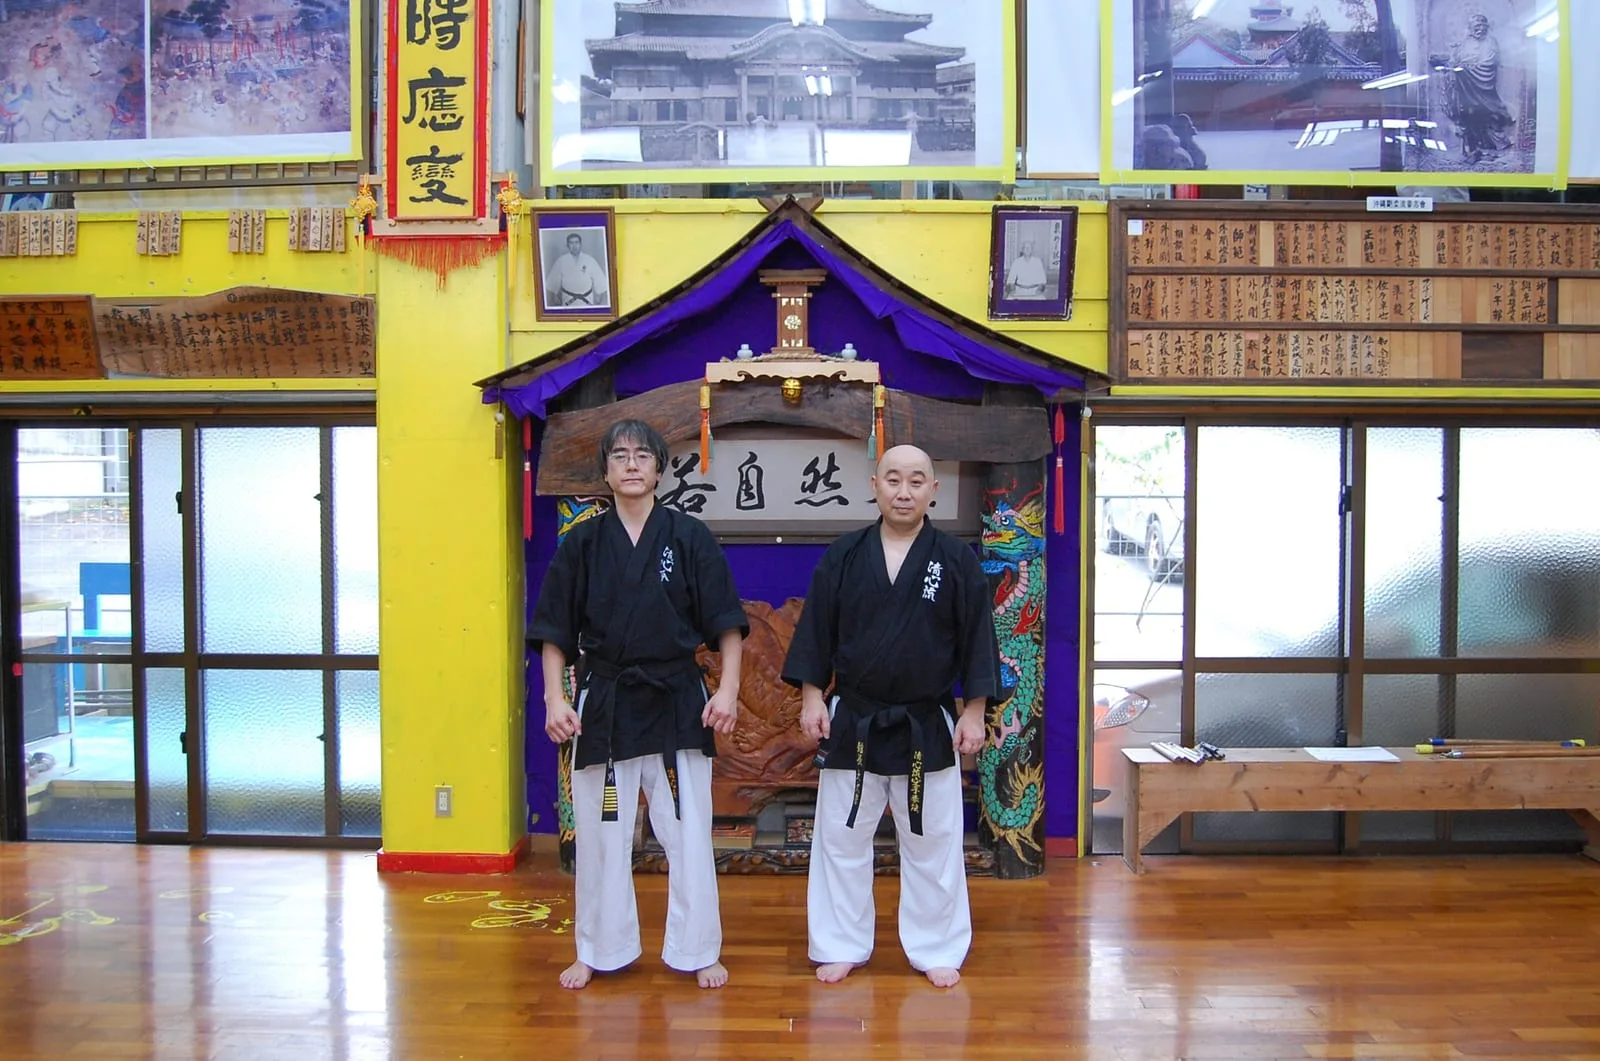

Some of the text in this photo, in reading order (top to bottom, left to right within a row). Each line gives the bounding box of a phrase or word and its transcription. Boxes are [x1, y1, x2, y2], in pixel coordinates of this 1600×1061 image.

[1492, 283, 1503, 322] 少年部
[921, 559, 944, 603] 清心流
